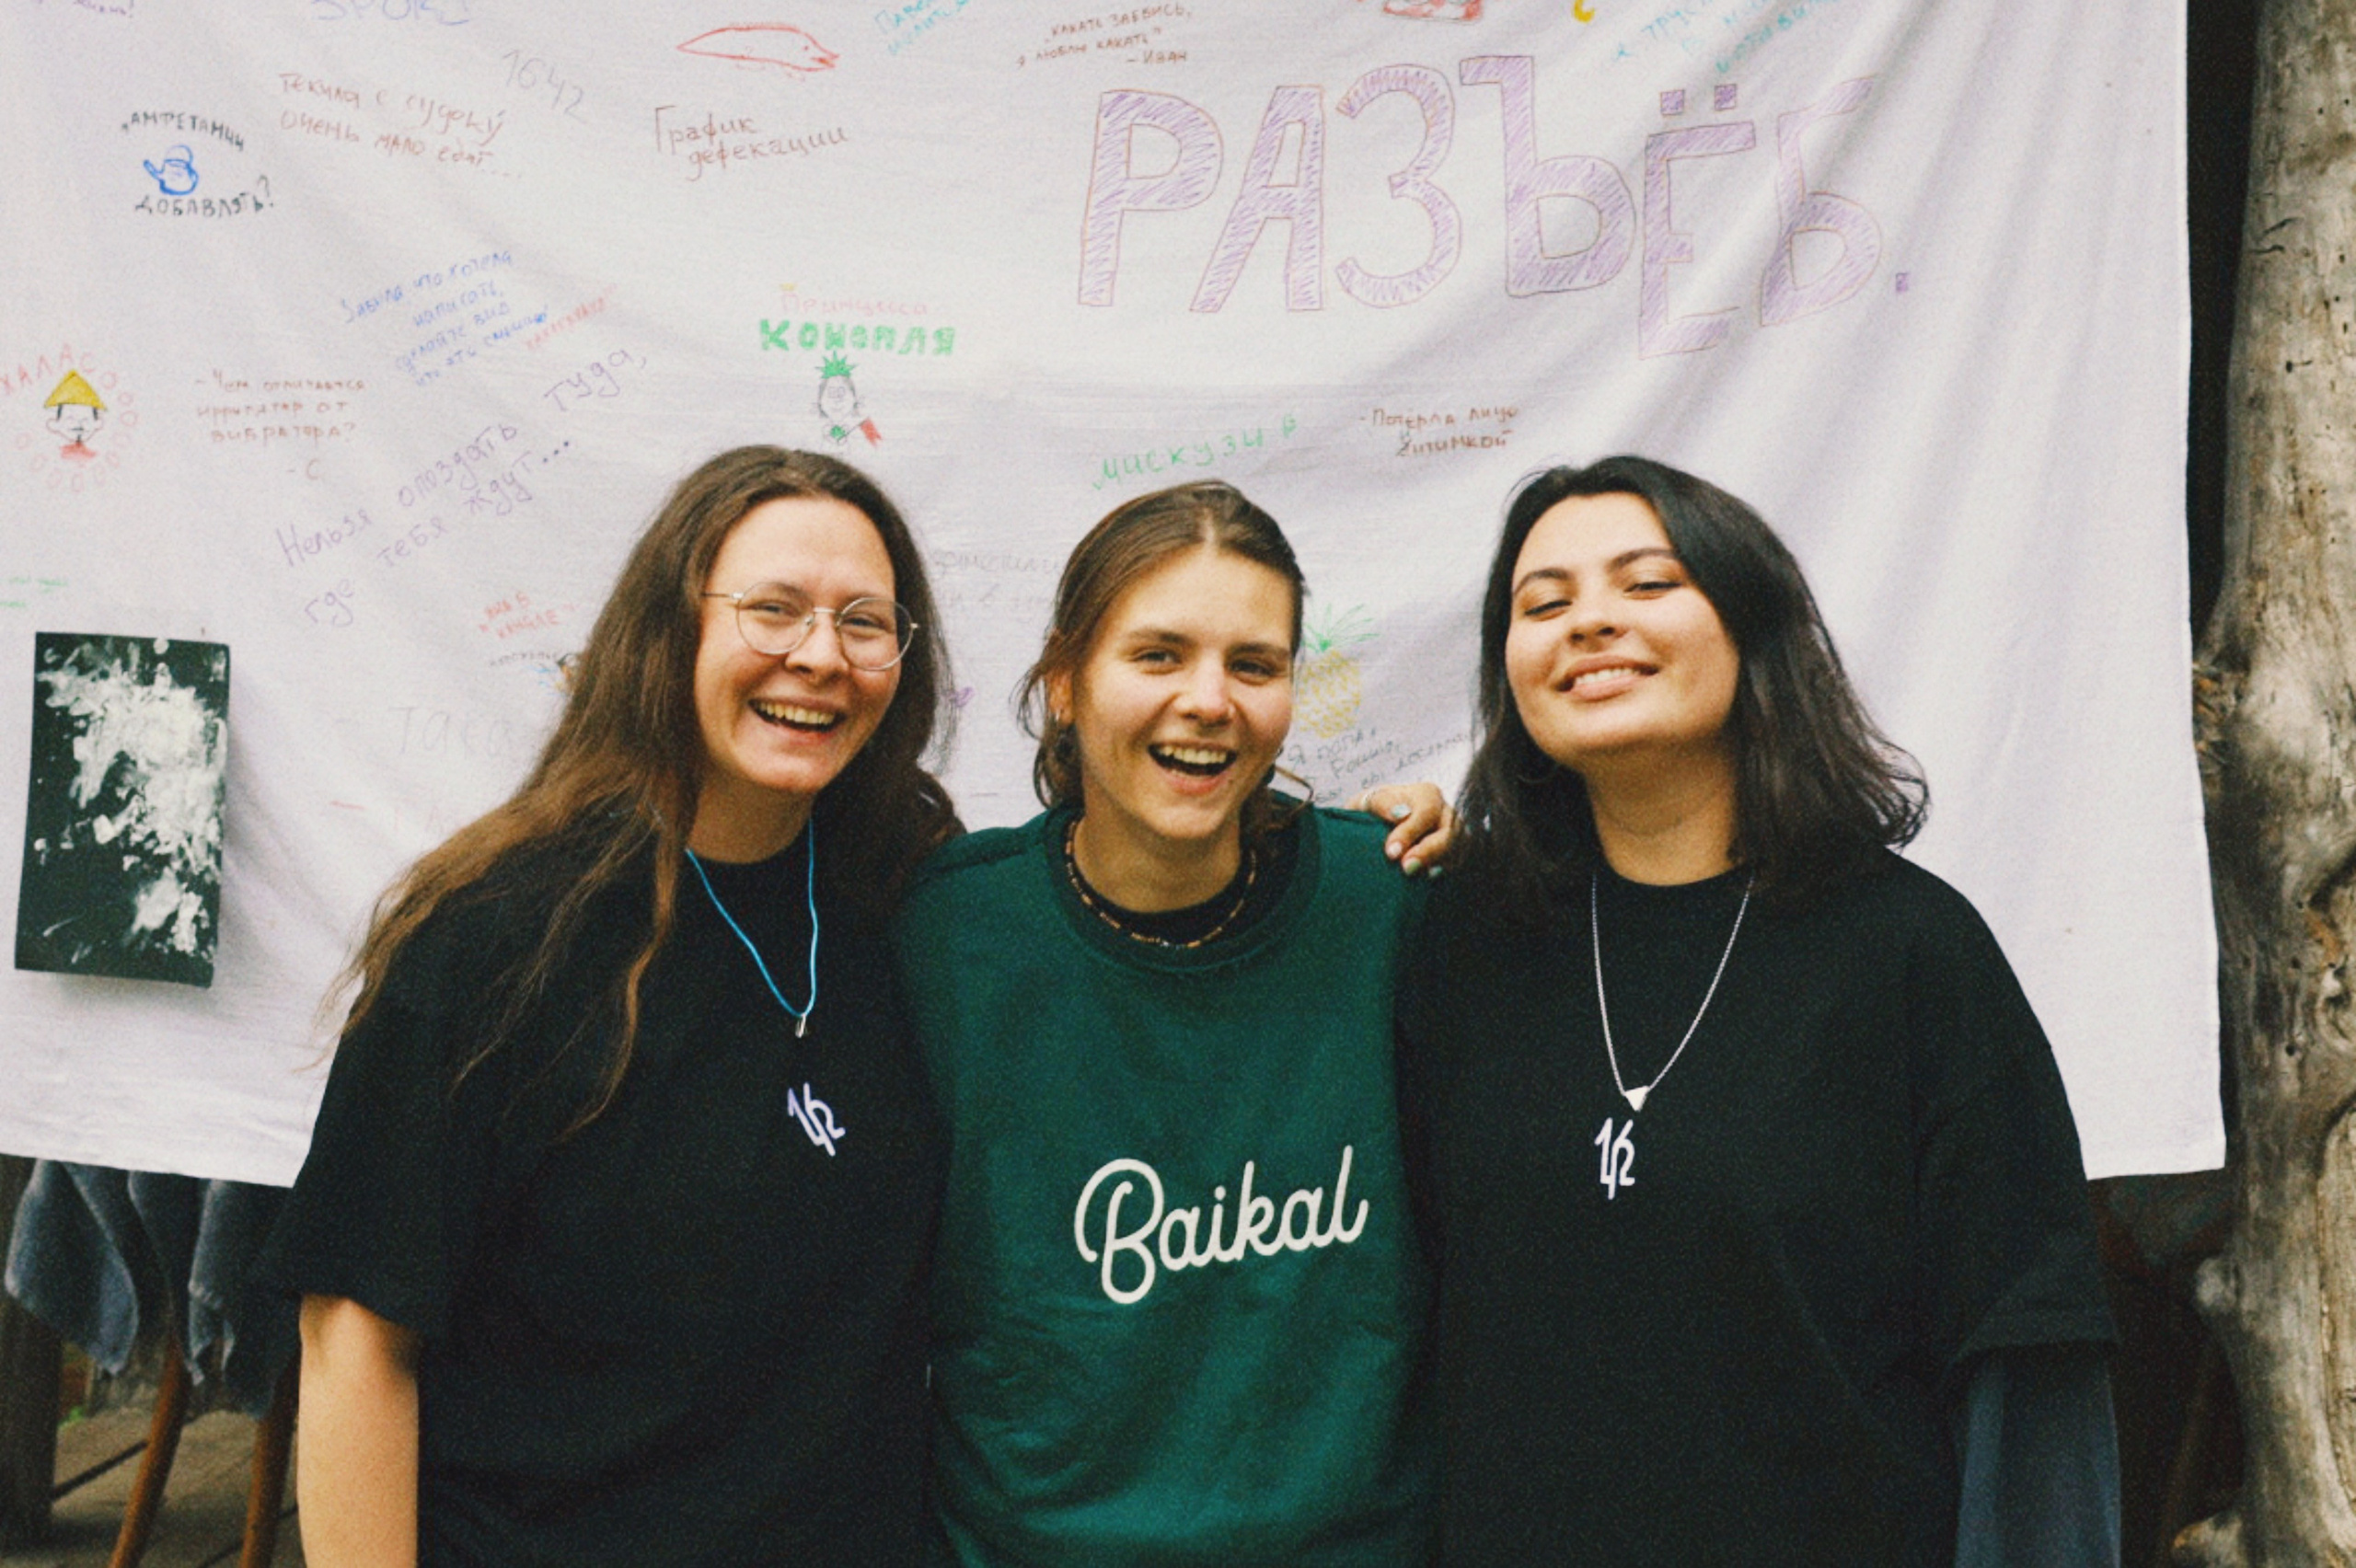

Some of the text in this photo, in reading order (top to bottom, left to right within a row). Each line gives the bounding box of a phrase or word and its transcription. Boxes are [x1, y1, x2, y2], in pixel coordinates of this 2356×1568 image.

[654, 105, 757, 155] График
[688, 127, 849, 182] дефекации
[781, 293, 928, 317] Принцесса
[759, 318, 956, 356] КОНОПЛЯ
[276, 508, 372, 567] Нельзя
[305, 578, 355, 627] где
[377, 513, 450, 567] тебя
[1074, 1144, 1369, 1305] Baikal
